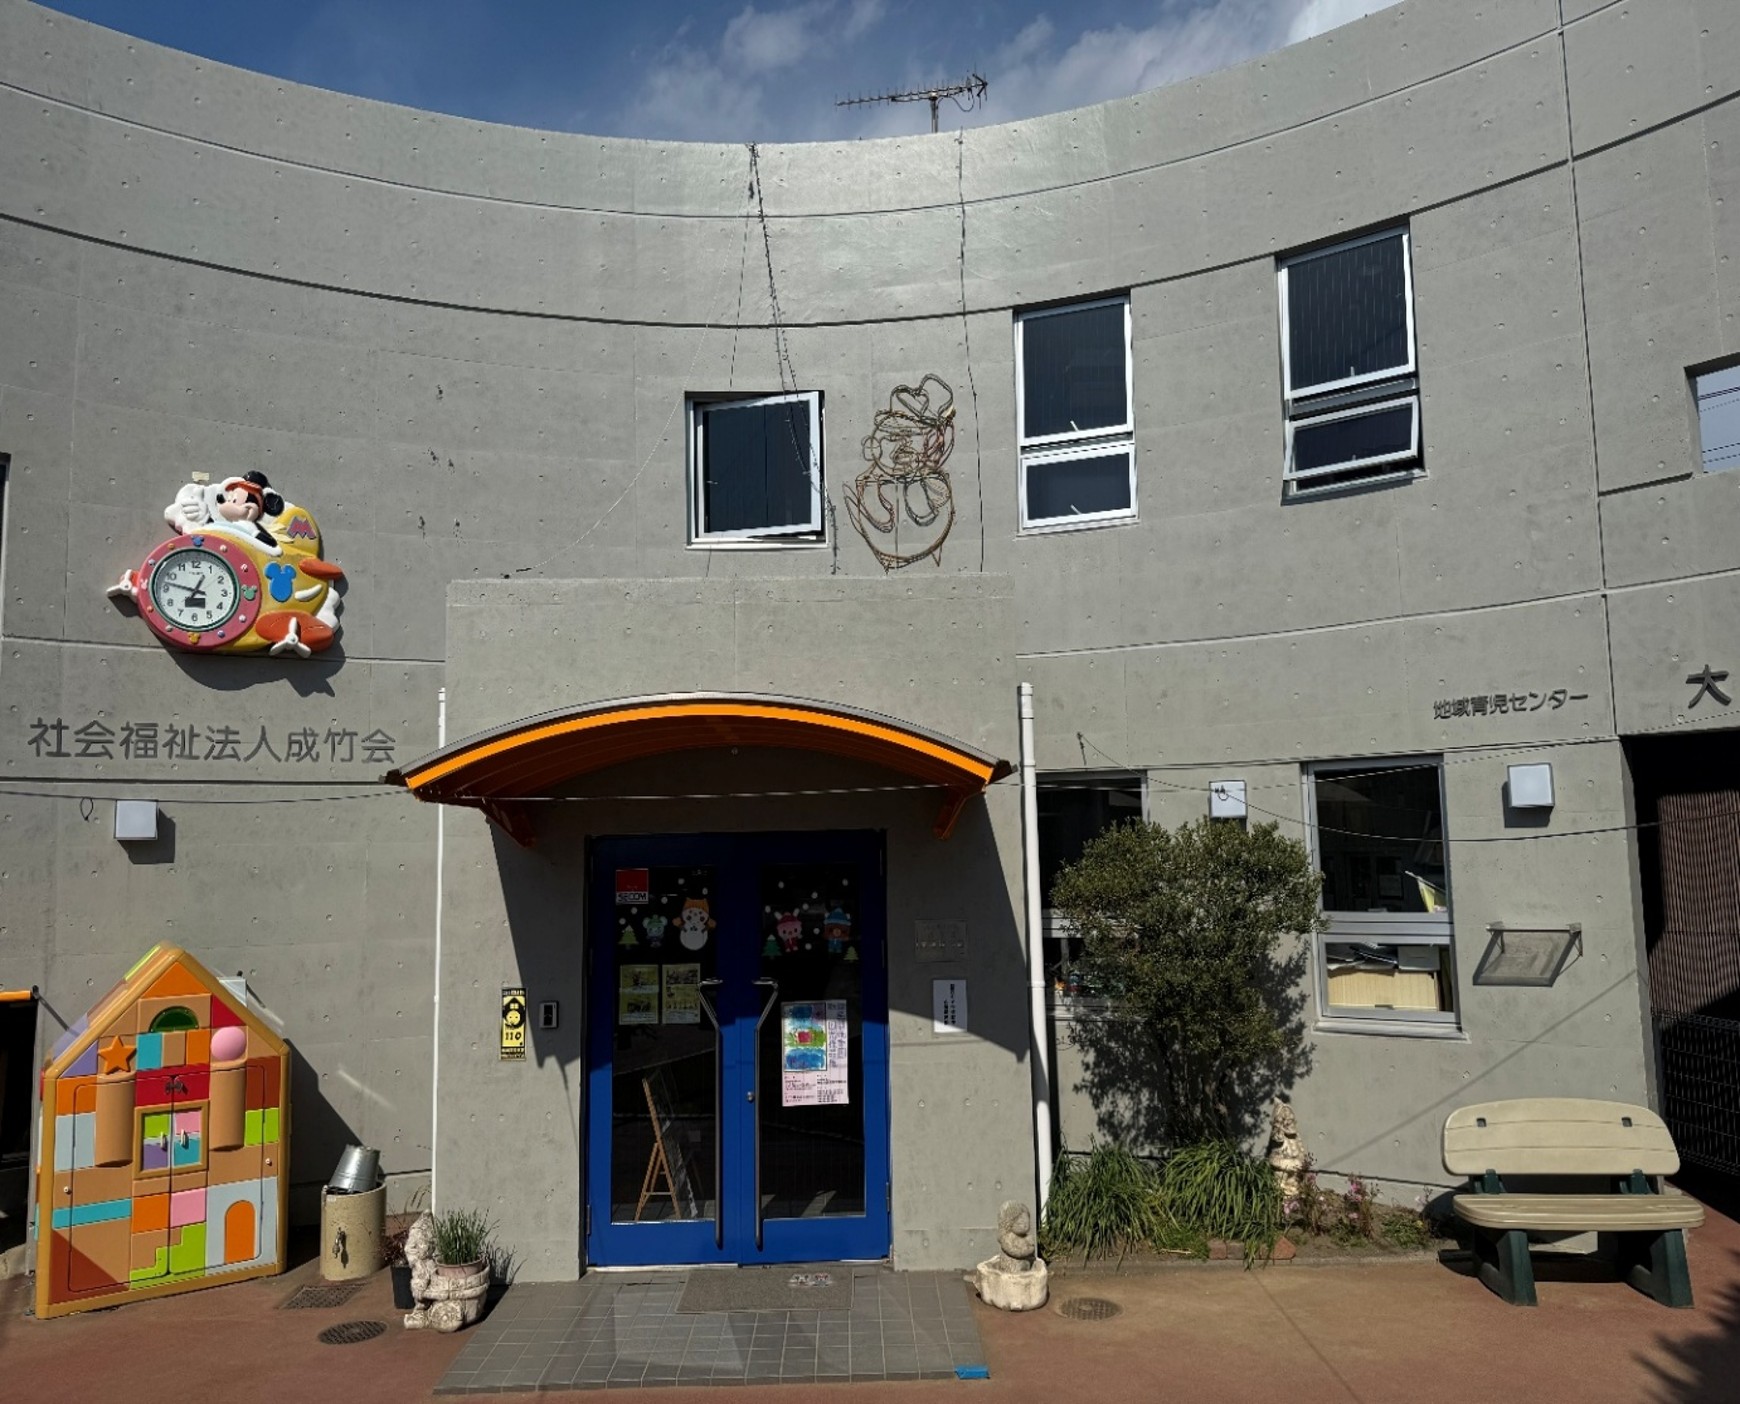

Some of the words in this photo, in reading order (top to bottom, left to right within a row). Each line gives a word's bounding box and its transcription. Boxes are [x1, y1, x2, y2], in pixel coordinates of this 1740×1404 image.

[178, 563, 186, 572] 11
[191, 560, 201, 569] 12
[208, 565, 213, 574] 1
[166, 572, 177, 581] 10
[217, 575, 225, 585] 2
[163, 583, 170, 593] 9
[221, 588, 228, 598] 3
[167, 598, 174, 607] 8
[216, 602, 224, 610] 4
[178, 608, 185, 617] 7
[191, 612, 198, 622] 6
[206, 610, 213, 619] 5
[1685, 664, 1732, 709] 大
[1433, 688, 1588, 720] 地域育児センター
[27, 717, 396, 764] 社会福祉法人成竹会
[617, 893, 647, 902] SECOM
[505, 1032, 522, 1041] 110
